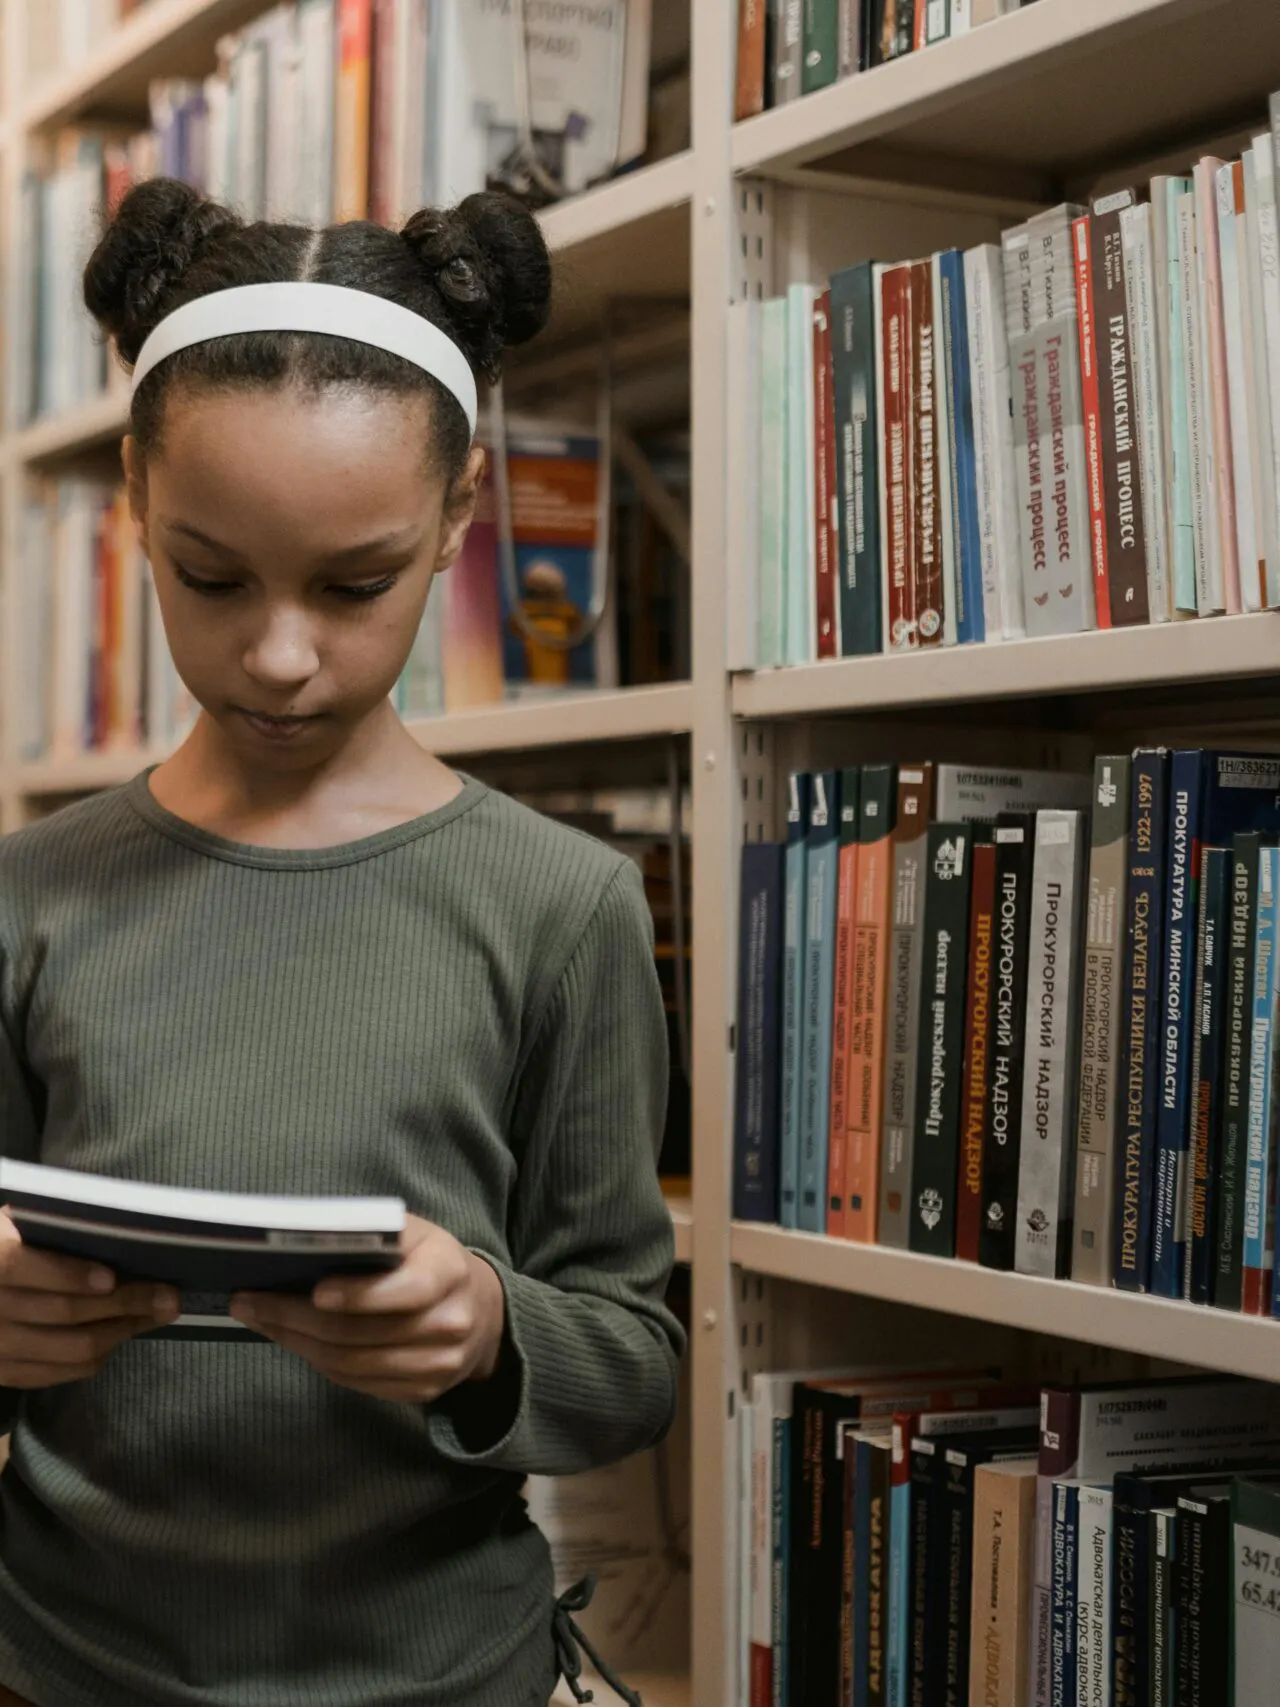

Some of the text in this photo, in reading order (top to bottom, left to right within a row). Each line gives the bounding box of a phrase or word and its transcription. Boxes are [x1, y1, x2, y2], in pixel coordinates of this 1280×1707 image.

[920, 323, 934, 564] ГРАЖДАНСКИЙ ПРОЦЕСС
[1044, 334, 1073, 563] Гражданский процесс
[1109, 314, 1135, 549] ГРАЖДАНСКИЙ ПРОЦЕСС
[1028, 493, 1048, 571] процесс
[1087, 413, 1106, 577] ГРАЖДАНСКИЙ ПРОЦЕСС
[837, 926, 848, 1007] ПРОКУРОРСКИЙ
[866, 931, 878, 1014] ПРОКУРОРСКИЙ
[894, 934, 912, 1054] ПРОКУРОРСКИЙ
[1087, 954, 1097, 965] В
[1164, 791, 1189, 1109] ПРОКУРАТУРА МИНСКОЙ ОБЛАСТИ
[1204, 935, 1214, 967] САВЧУК
[1229, 862, 1250, 1107] ПРОКУРОРСКИЙ НАДЗОР
[1255, 939, 1272, 1000] Шостак
[835, 1011, 846, 1050] НАДЗОР
[864, 1017, 874, 1059] НАДЗОР
[925, 929, 951, 1136] Прокурорский надзор
[992, 872, 1017, 1145] ПРОКУРОРСКИЙ НАДЗОР
[1084, 968, 1099, 1058] РОССИЙСКОЙ
[1094, 955, 1114, 1121] ПРОКУРОРСКИЙ НАДЗОР
[1121, 773, 1153, 1270] ПРОКУРАТУРА РЕСПУБЛИКИ БЕЛАРУСЬ 1922-1997
[1202, 999, 1211, 1035] ГАСАНОВ
[891, 1060, 907, 1121] НАДЗОР
[964, 913, 992, 1194] ПРОКУРОРСКИЙ НАДЗОР
[1080, 1062, 1093, 1144] ФЕДЕРАЦИИ
[1195, 1080, 1212, 1180] ПРОКУРОРСКИЙ
[1226, 1122, 1238, 1166] Жильцов
[1244, 1017, 1270, 1239] Прокурорский надзор
[1154, 1147, 1168, 1262] современность
[1163, 1150, 1177, 1215] История
[1193, 1185, 1207, 1238] НАДЗОР
[949, 1508, 963, 1624] НАСТОЛЬНАЯ
[1052, 1521, 1065, 1607] АДВОКАТУРА
[1119, 1526, 1135, 1612] РОССИИ
[1154, 1560, 1163, 1647] ДЕЯТЕЛЬНОСТИ
[1188, 1521, 1204, 1616] Федерации
[947, 1629, 959, 1685] КНИГА
[1037, 1592, 1050, 1697] ПРОФЕССИОНАЛЬНЫЕ
[1054, 1613, 1064, 1624] И
[1077, 1601, 1091, 1644] (курс
[1091, 1526, 1107, 1707] Адвокатская деятельнос
